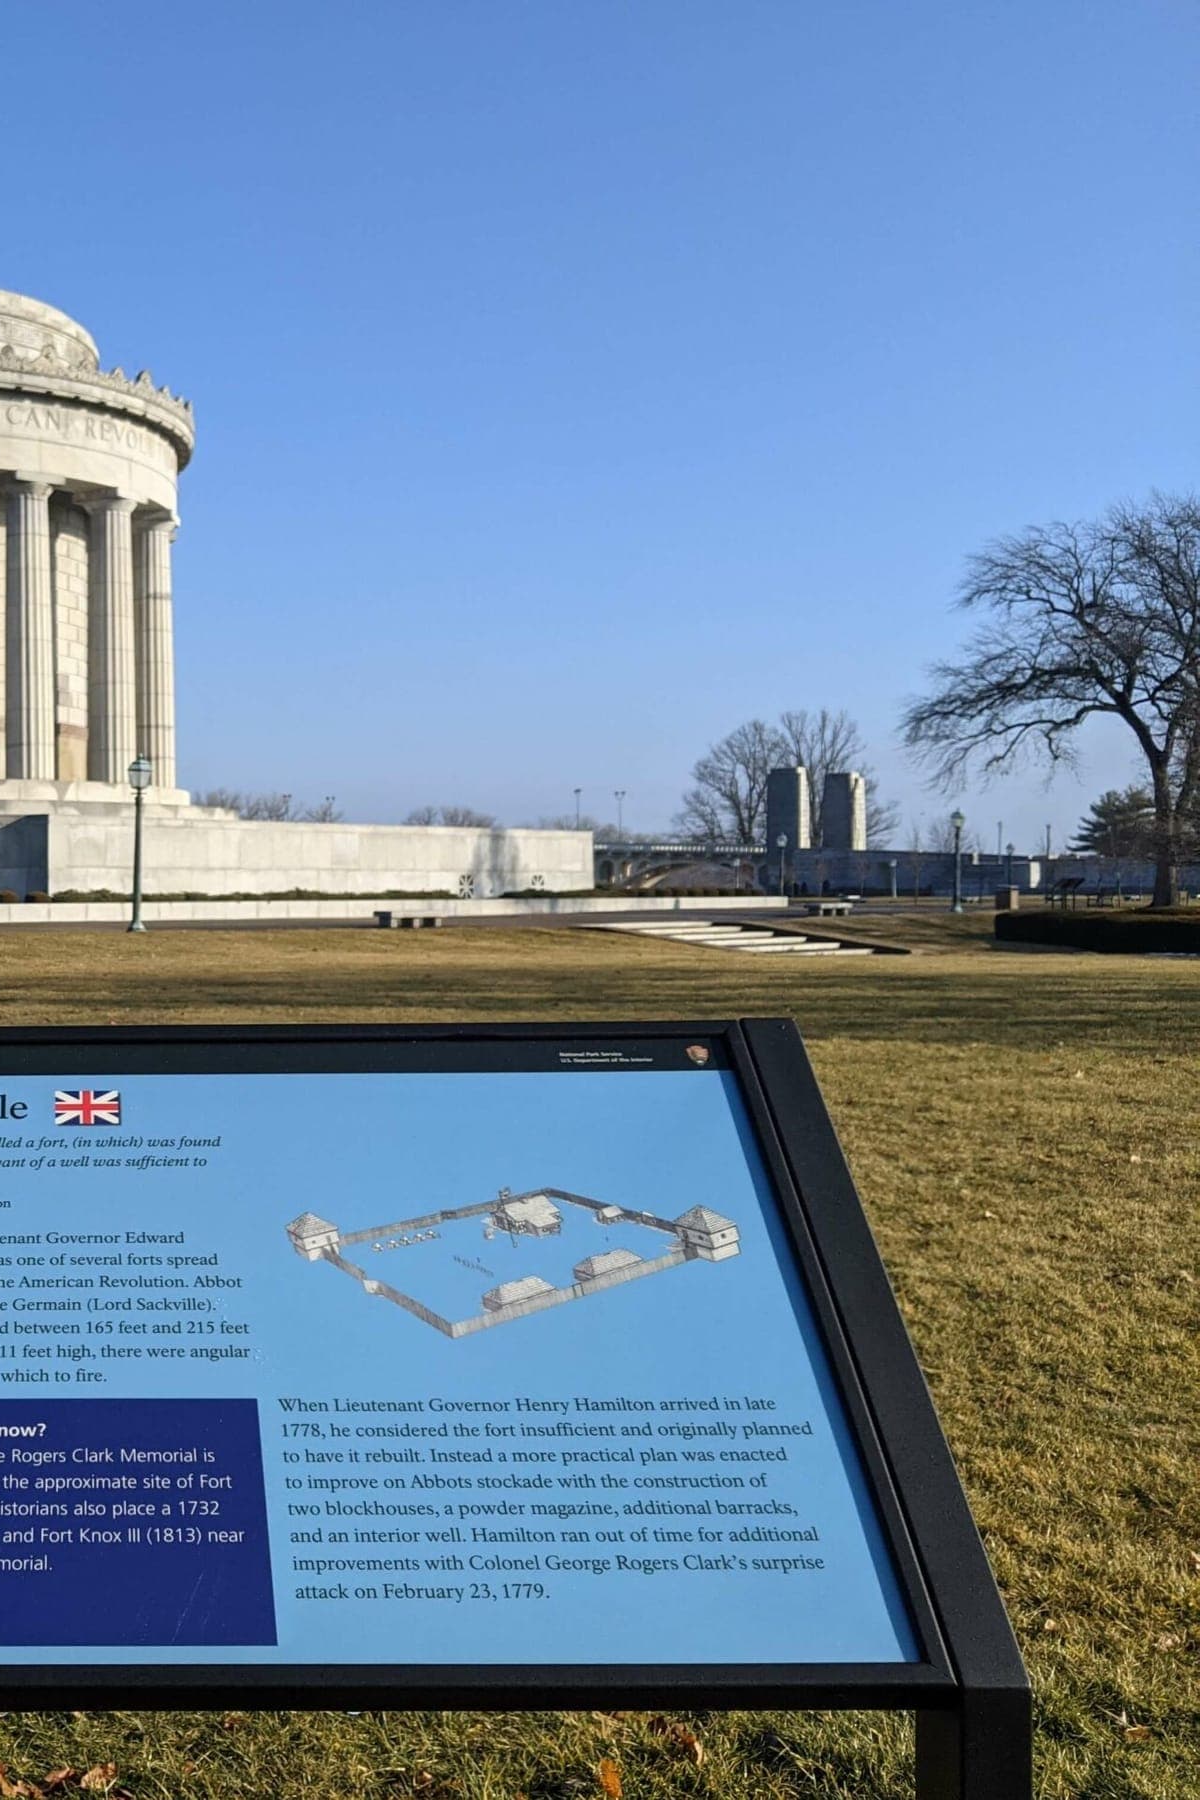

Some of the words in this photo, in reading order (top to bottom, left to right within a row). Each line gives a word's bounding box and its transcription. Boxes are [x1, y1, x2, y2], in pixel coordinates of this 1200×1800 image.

[45, 1231, 121, 1244] Governor
[124, 1231, 184, 1244] Edward
[16, 1256, 45, 1266] one
[49, 1252, 67, 1265] of
[69, 1253, 122, 1266] several
[127, 1252, 163, 1265] forts
[166, 1252, 218, 1269] spread
[12, 1297, 81, 1311] Germain
[86, 1297, 131, 1313] (Lord
[136, 1297, 216, 1312] Sackville).
[13, 1320, 80, 1334] between
[86, 1320, 113, 1334] 165
[118, 1320, 147, 1334] feet
[152, 1320, 182, 1334] and
[186, 1320, 214, 1334] 215
[220, 1320, 249, 1334] feet
[0, 1368, 49, 1382] which
[54, 1370, 70, 1382] to
[75, 1367, 107, 1382] fire.
[277, 1397, 329, 1412] When
[332, 1398, 424, 1412] Lieutenant
[428, 1398, 510, 1412] Governor
[514, 1397, 569, 1415] Henry
[573, 1396, 655, 1411] Hamilton
[659, 1396, 720, 1411] arrived
[723, 1396, 741, 1410] in
[743, 1396, 776, 1410] late
[282, 1423, 326, 1439] 1778,
[329, 1422, 350, 1437] he
[355, 1422, 448, 1437] considered
[452, 1422, 480, 1437] the
[484, 1422, 516, 1437] fort
[519, 1421, 616, 1436] insufficient
[620, 1421, 653, 1436] and
[657, 1421, 737, 1440] originally
[741, 1420, 813, 1440] planned
[11, 1448, 66, 1466] Rogers
[72, 1447, 114, 1463] Clark
[120, 1447, 197, 1462] Memorial
[203, 1447, 215, 1462] is
[2, 1473, 29, 1489] the
[34, 1473, 137, 1492] approximate
[142, 1473, 171, 1488] site
[176, 1473, 193, 1488] of
[199, 1474, 232, 1488] Fort
[284, 1476, 302, 1489] to
[307, 1474, 378, 1493] improve
[383, 1478, 405, 1488] on
[410, 1473, 472, 1489] Abbots
[476, 1473, 553, 1488] stockade
[556, 1473, 596, 1488] with
[599, 1473, 629, 1488] the
[633, 1473, 745, 1488] construction
[748, 1472, 767, 1488] of
[73, 1500, 106, 1515] also
[112, 1500, 155, 1519] place
[161, 1503, 170, 1515] a
[178, 1500, 219, 1515] 1732
[287, 1503, 320, 1516] two
[324, 1500, 440, 1518] blockhouses,
[443, 1504, 454, 1515] a
[458, 1499, 525, 1519] powder
[530, 1500, 619, 1519] magazine,
[622, 1499, 712, 1515] additional
[714, 1498, 798, 1517] barracks,
[2, 1527, 34, 1543] and
[40, 1527, 73, 1543] Fort
[79, 1527, 122, 1543] Knox
[128, 1527, 140, 1542] III
[146, 1526, 201, 1545] (1813)
[207, 1530, 245, 1542] near
[292, 1555, 420, 1575] improvements
[424, 1554, 464, 1570] with
[468, 1554, 541, 1570] Colonel
[544, 1554, 611, 1575] George
[615, 1554, 679, 1575] Rogers
[751, 1554, 825, 1574] surprise
[295, 1583, 349, 1599] attack
[354, 1587, 378, 1599] on
[381, 1582, 464, 1603] February
[469, 1583, 497, 1601] 23,
[502, 1583, 550, 1599] 1779.
